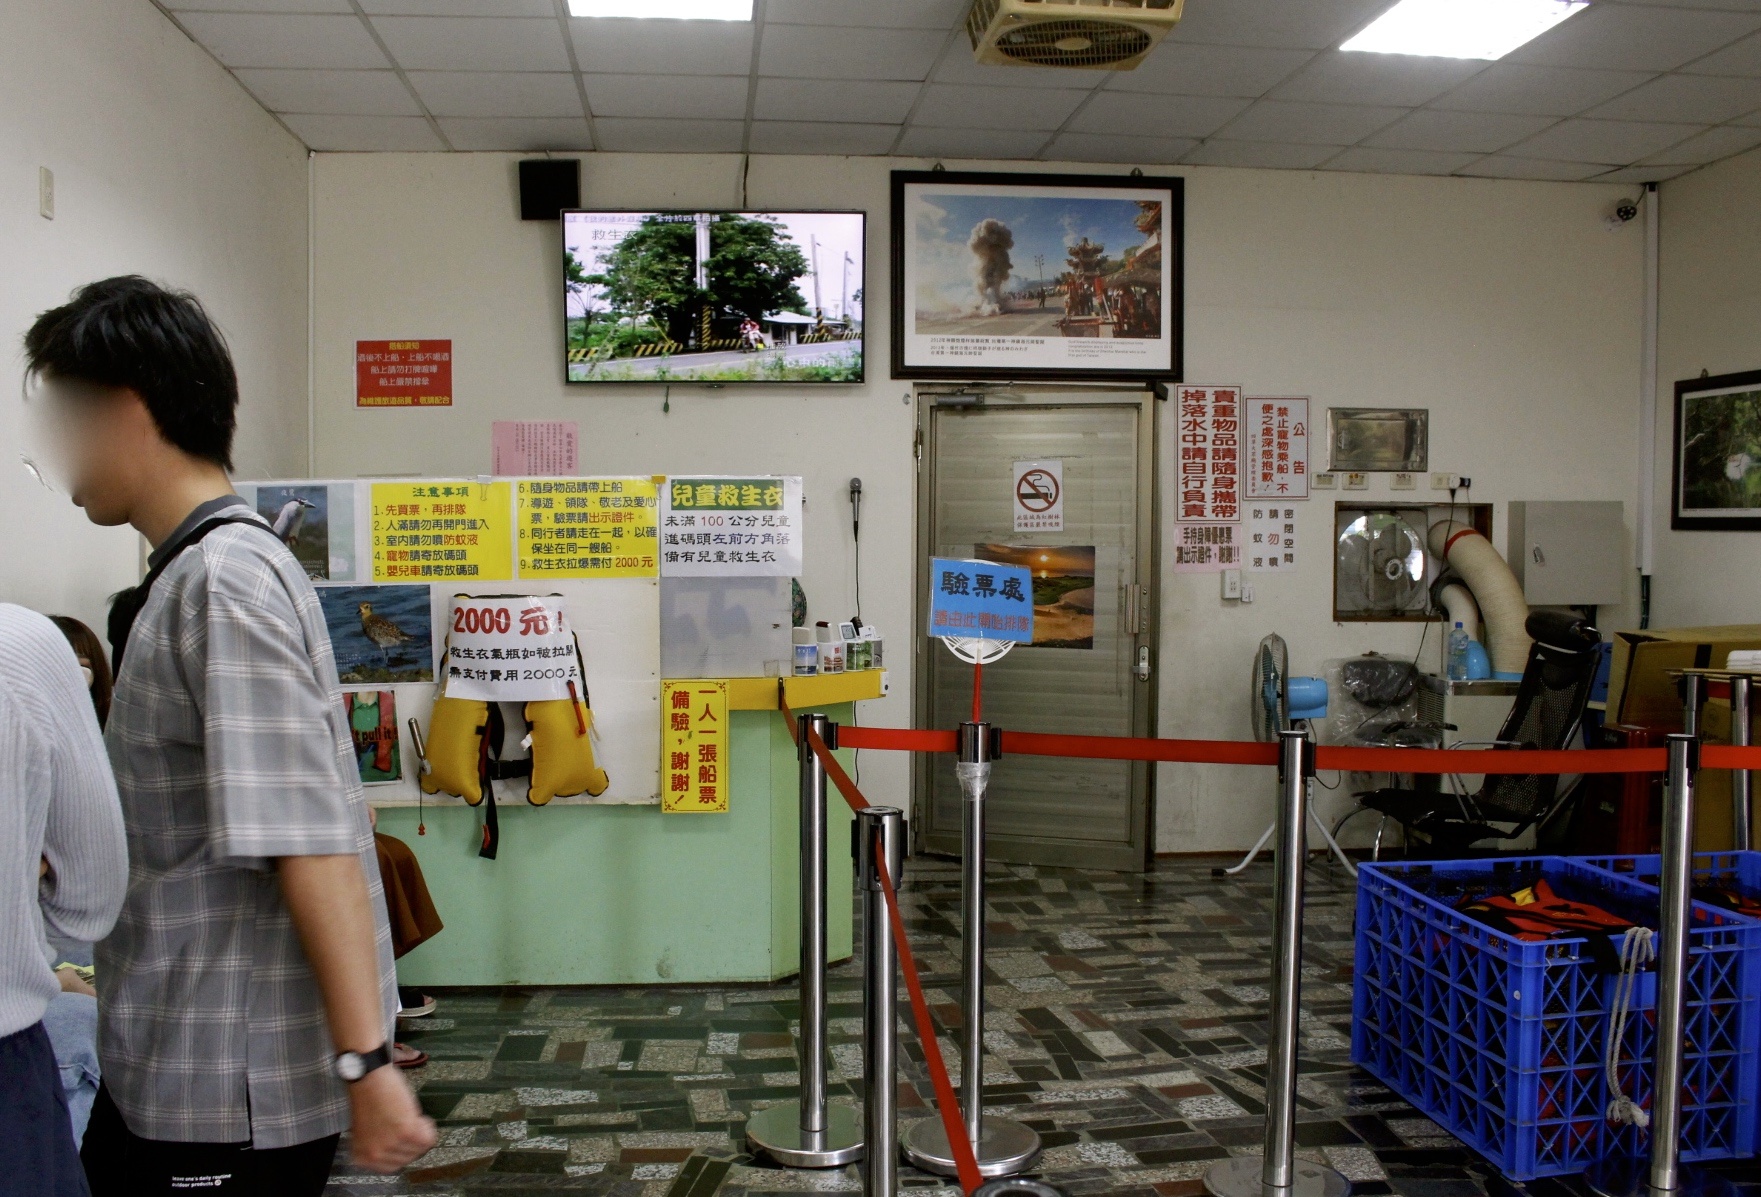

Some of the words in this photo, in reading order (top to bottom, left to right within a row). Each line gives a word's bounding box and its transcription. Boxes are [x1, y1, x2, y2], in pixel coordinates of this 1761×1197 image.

[1182, 390, 1207, 518] 掉落水中請自行負責
[1212, 390, 1237, 518] 貴重物品請隨身攜帶
[412, 486, 469, 498] 注意事項
[672, 484, 783, 506] 兒童救生衣
[665, 533, 791, 545] 進碼頭左前方角落
[665, 550, 776, 563] 備有兒童救生衣
[941, 571, 1025, 602] 驗票處
[362, 726, 382, 744] pull
[698, 690, 717, 804] 一人一張船票
